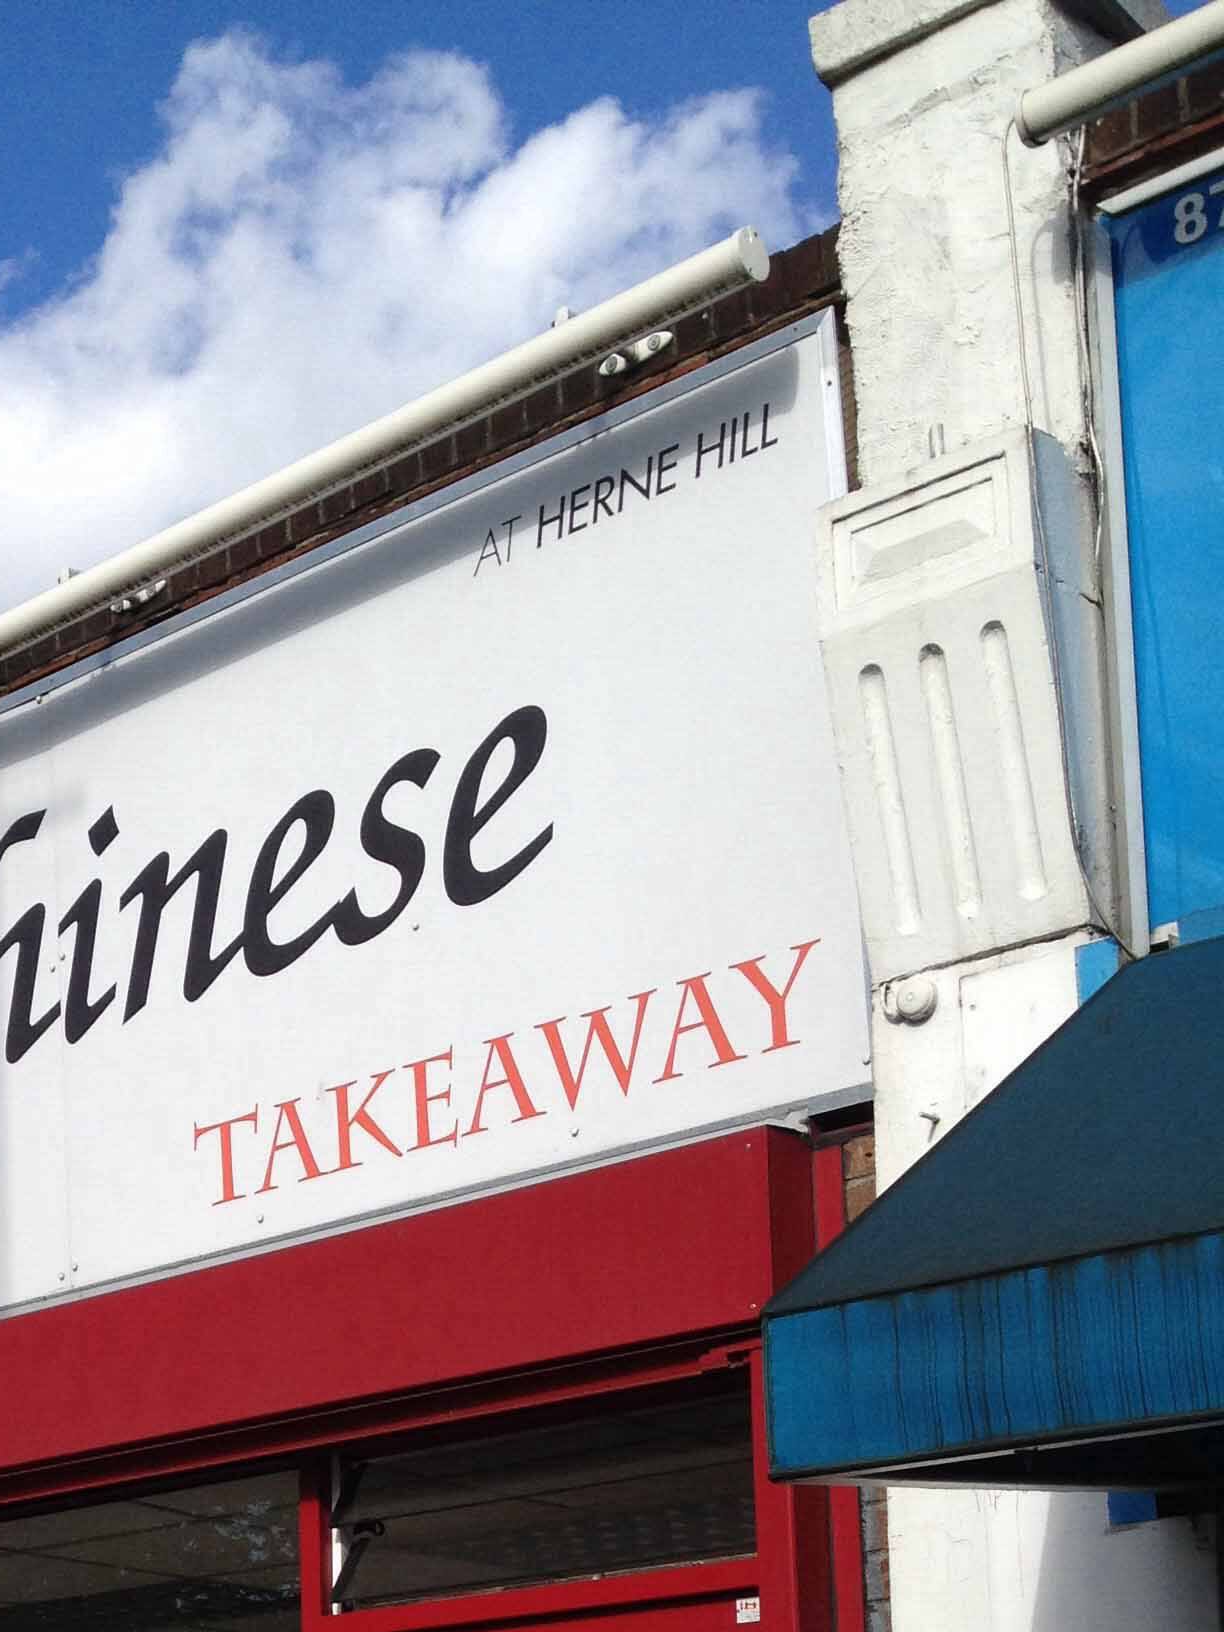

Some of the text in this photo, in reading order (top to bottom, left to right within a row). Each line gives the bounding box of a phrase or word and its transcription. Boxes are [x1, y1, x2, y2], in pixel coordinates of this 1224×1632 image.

[473, 402, 779, 577] AT HERNE HILL
[193, 937, 822, 1207] TAKEAWAY
